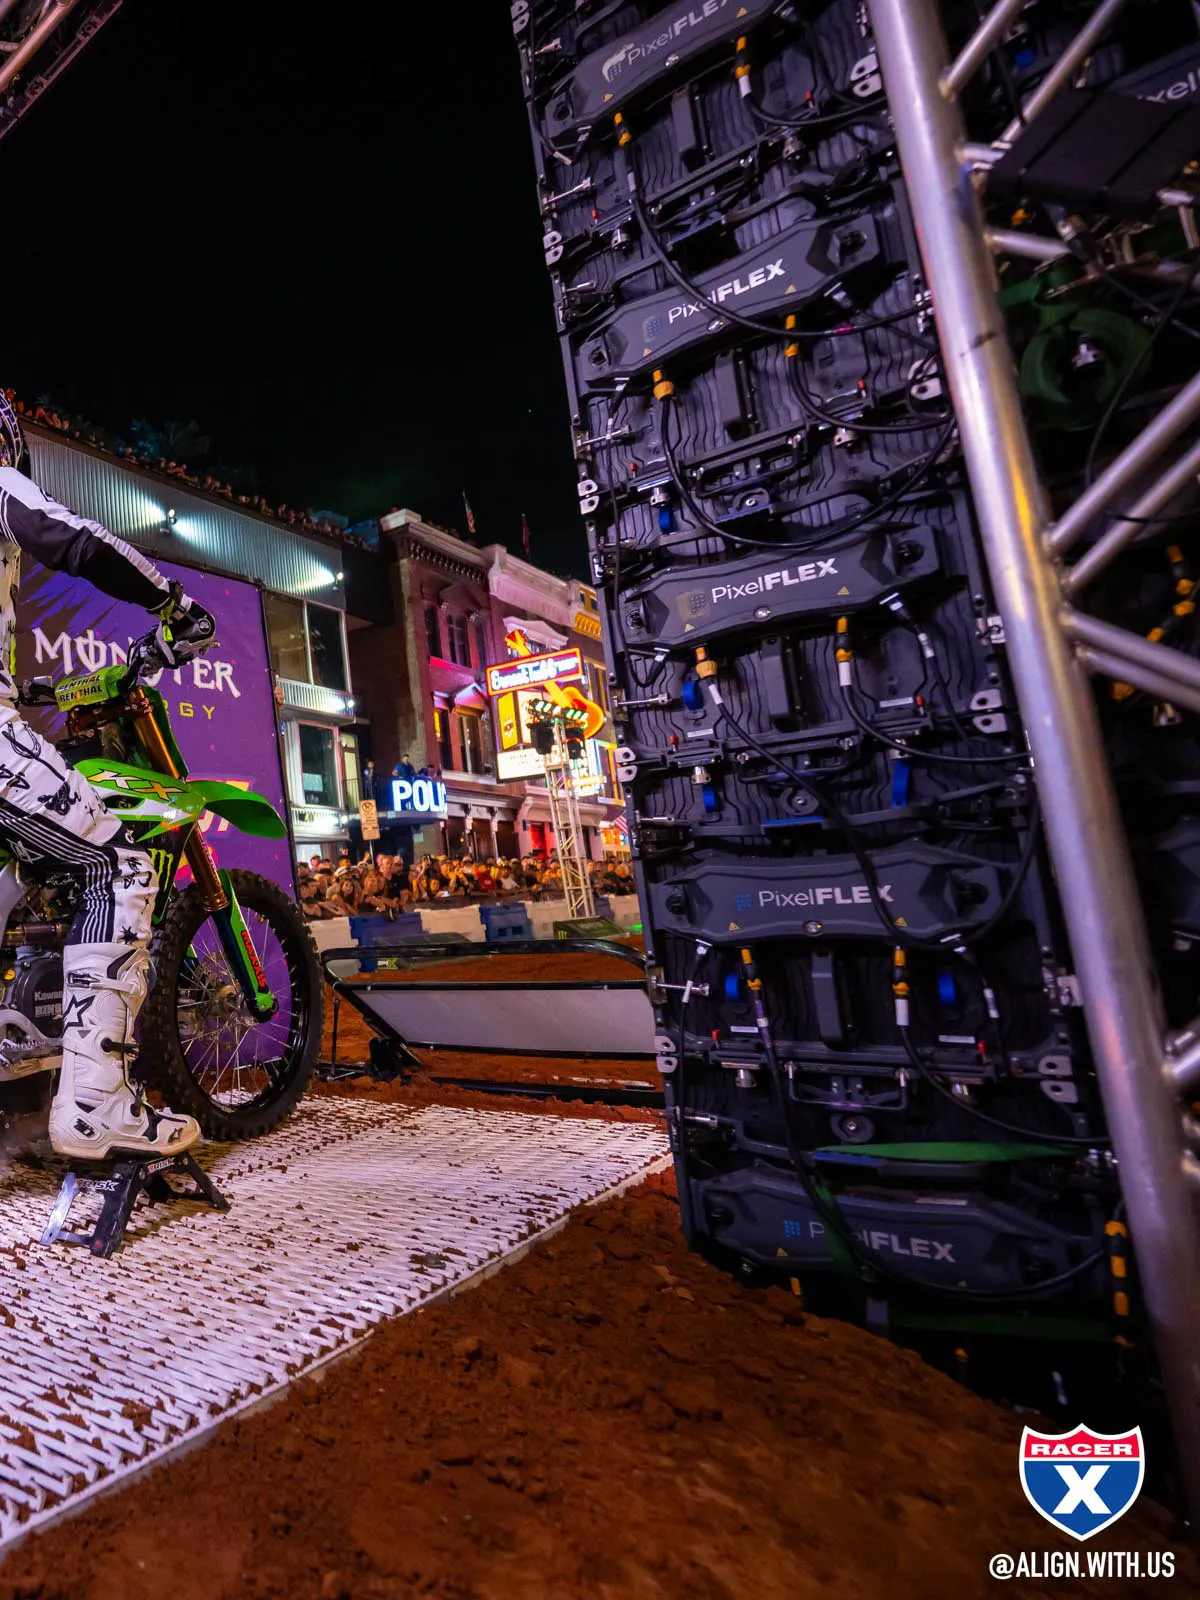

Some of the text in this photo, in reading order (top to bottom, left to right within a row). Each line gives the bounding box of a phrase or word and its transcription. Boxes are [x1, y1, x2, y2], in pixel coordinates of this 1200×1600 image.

[628, 0, 727, 66] PixelFLE
[711, 557, 839, 603] PixelFLEX
[59, 684, 104, 702] RENTHAL
[87, 767, 191, 802] KX
[758, 884, 894, 908] PixelFLEX
[808, 1221, 957, 1264] PlFLEX
